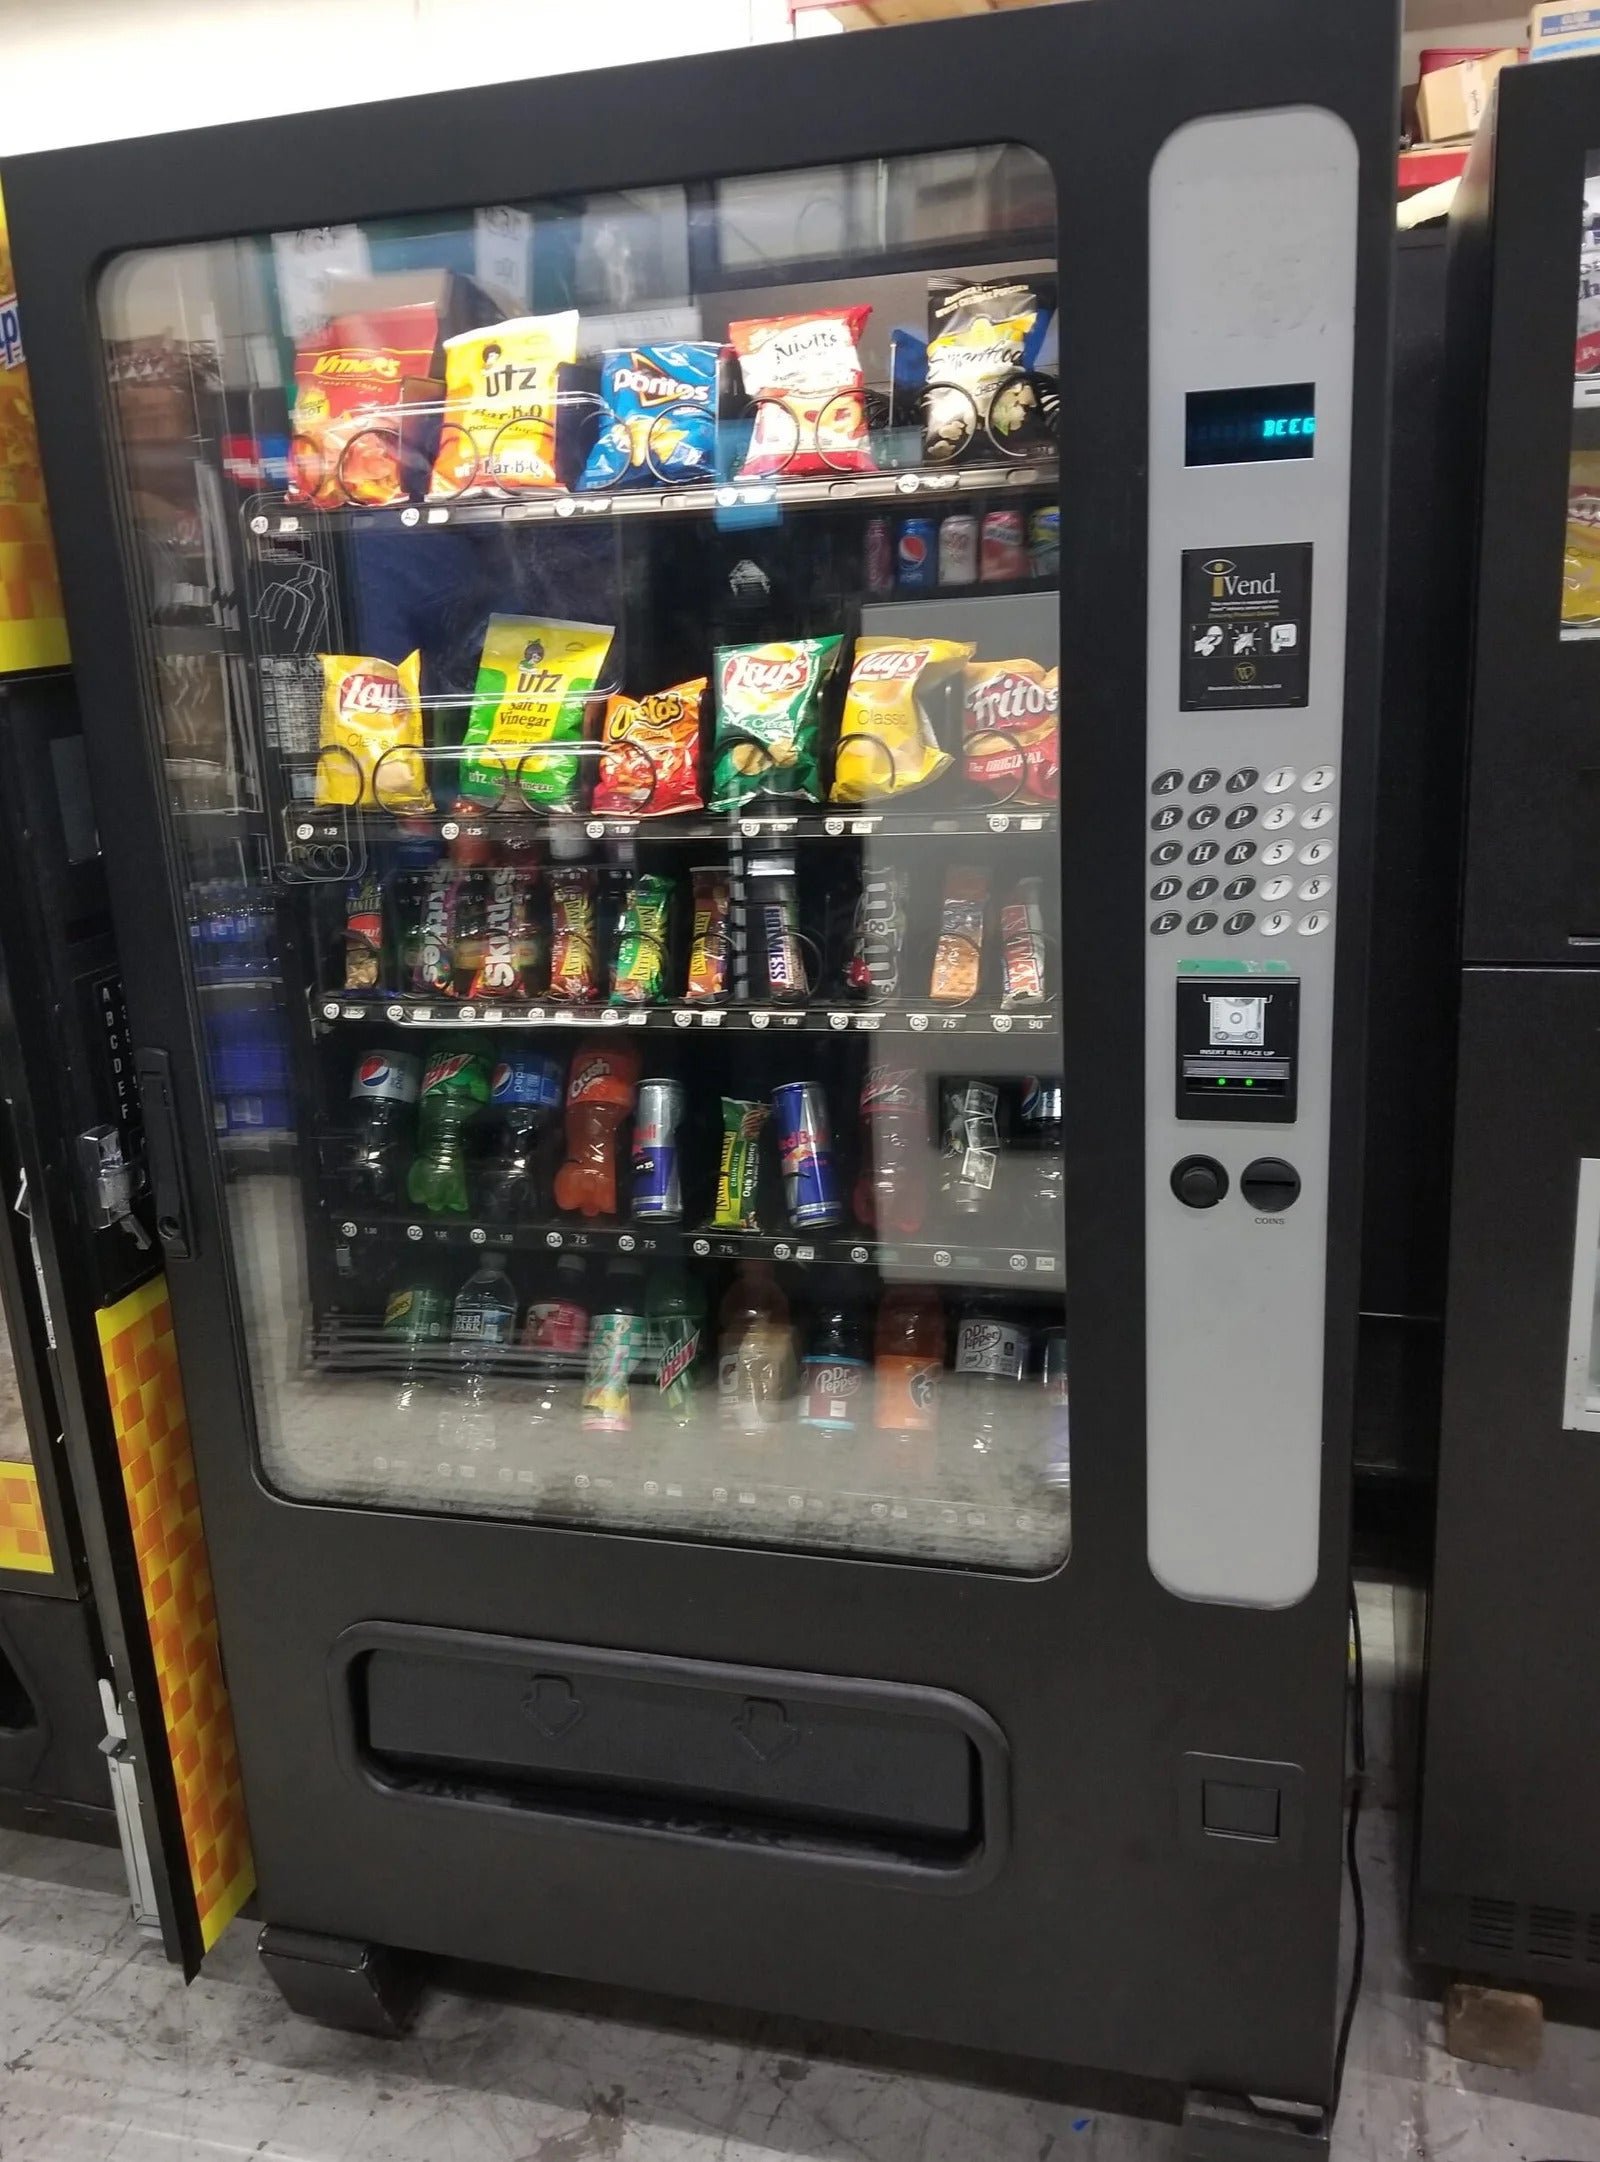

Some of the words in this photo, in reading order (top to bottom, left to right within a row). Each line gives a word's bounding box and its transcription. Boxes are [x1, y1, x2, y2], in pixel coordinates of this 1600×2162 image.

[613, 368, 710, 401] Doritos
[964, 675, 1059, 729] Fritos
[500, 710, 551, 729] Vinegar
[1160, 776, 1174, 790] A
[1196, 774, 1212, 788] F
[1233, 773, 1249, 788] N
[1275, 772, 1284, 787] 1
[1313, 771, 1324, 786] 2
[1160, 812, 1174, 826] B
[1196, 810, 1211, 825] G
[1234, 810, 1249, 824] P
[1273, 808, 1283, 823] 3
[1312, 808, 1323, 822] 4
[1159, 846, 1174, 860] C
[1194, 846, 1211, 860] H
[1232, 846, 1248, 860] R
[1273, 845, 1283, 859] 5
[1310, 844, 1319, 859] 6
[1159, 882, 1174, 896] D
[1196, 882, 1209, 896] J
[1233, 881, 1247, 895] T
[1272, 880, 1282, 894] 7
[1309, 880, 1320, 895] 8
[1159, 916, 1174, 930] E
[1195, 916, 1208, 930] L
[1231, 916, 1246, 930] U
[1272, 915, 1281, 929] 9
[1308, 915, 1318, 930] 0
[102, 987, 111, 1001] A
[106, 1011, 114, 1027] B
[942, 1018, 956, 1029] 75
[1028, 1020, 1044, 1030] 90
[110, 1034, 118, 1050] C
[114, 1058, 122, 1073] D
[118, 1080, 126, 1097] E
[121, 1103, 129, 1120] F
[746, 1141, 758, 1168] Honey
[1254, 1217, 1285, 1225] COINS
[575, 1235, 588, 1244] 75
[643, 1240, 657, 1249] 75
[720, 1244, 733, 1254] 75
[455, 1314, 481, 1323] DEER
[455, 1322, 481, 1332] PARK
[833, 1366, 850, 1380] Dr
